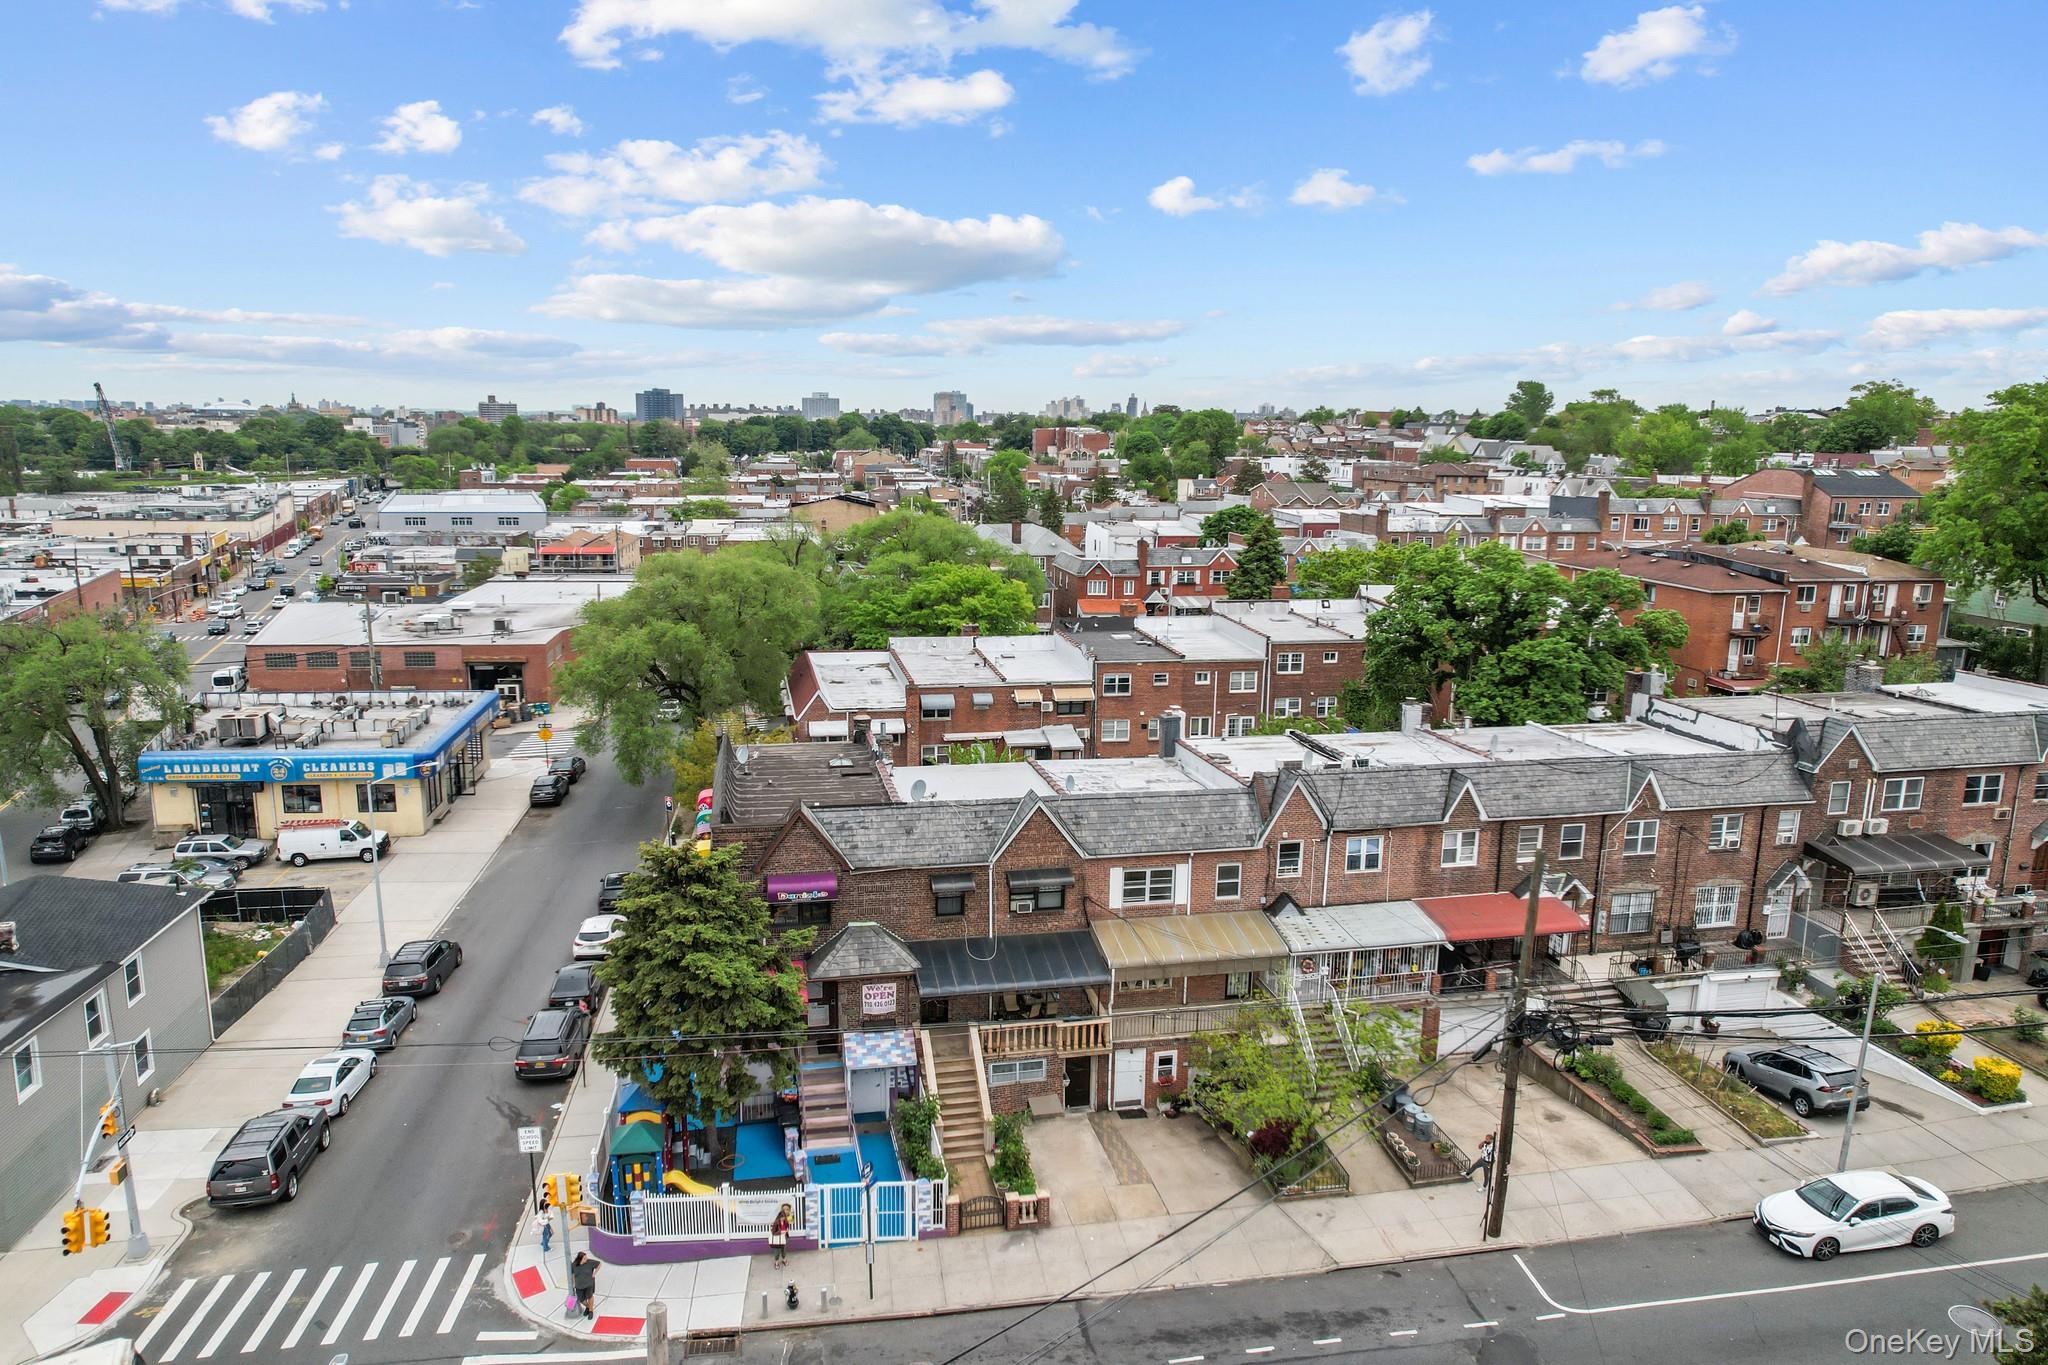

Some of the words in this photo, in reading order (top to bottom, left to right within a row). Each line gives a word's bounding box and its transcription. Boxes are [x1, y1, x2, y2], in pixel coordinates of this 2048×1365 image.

[163, 763, 260, 774] LAUNDROMAT
[302, 762, 375, 772] CLEANERS
[864, 991, 895, 1000] OPEN
